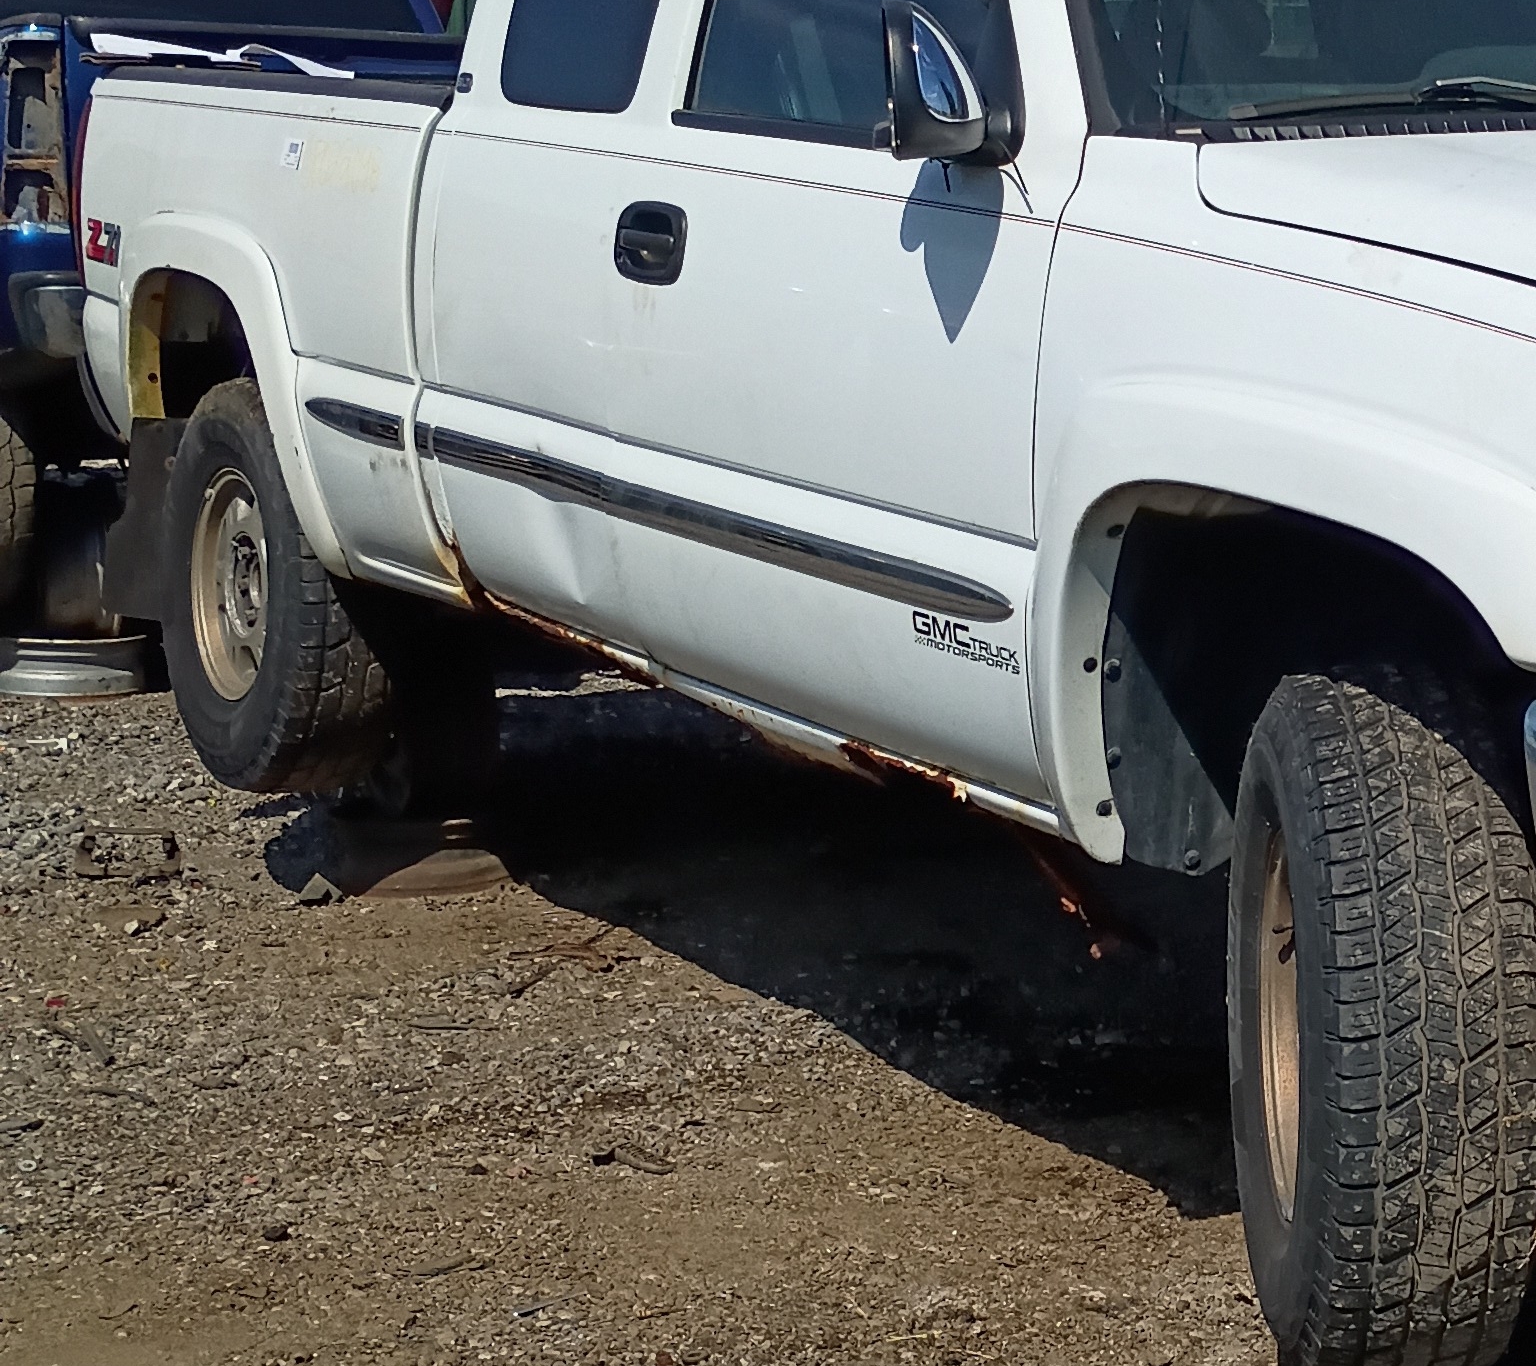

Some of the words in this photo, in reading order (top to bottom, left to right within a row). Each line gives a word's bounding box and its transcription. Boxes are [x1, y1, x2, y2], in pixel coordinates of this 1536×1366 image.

[86, 218, 121, 267] Z71
[912, 610, 971, 649] GMC
[969, 636, 1019, 665] TRUCK
[927, 637, 1020, 675] MOTORSPORTS
